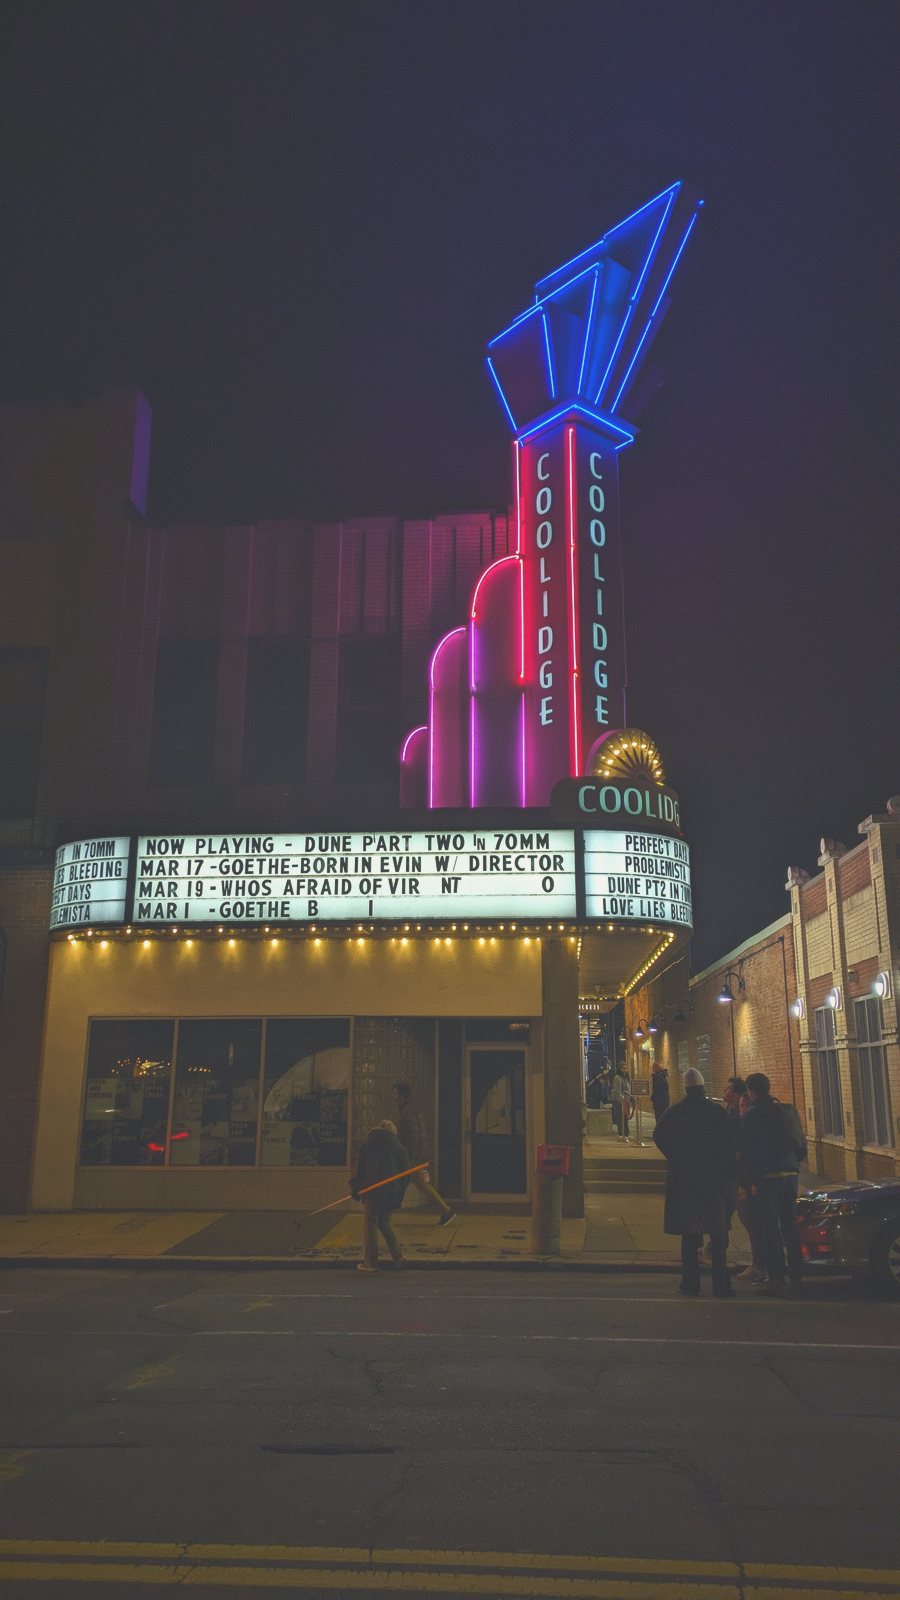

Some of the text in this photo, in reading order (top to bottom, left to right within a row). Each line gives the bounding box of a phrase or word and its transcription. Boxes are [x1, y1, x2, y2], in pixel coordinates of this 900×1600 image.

[536, 452, 554, 726] COOLIDGE
[589, 452, 609, 725] COOLIDGE
[72, 844, 82, 860] IN
[84, 840, 116, 858] 70MM
[146, 839, 185, 856] NOW
[195, 837, 274, 855] PLAYING
[304, 836, 352, 852] DUNE
[425, 834, 465, 851] TWO
[493, 833, 550, 850] 70MM
[625, 834, 671, 856] PERFECT
[69, 860, 123, 882] BLEEDING
[140, 860, 179, 877] MAR
[187, 859, 204, 876] 17
[380, 856, 422, 873] EVIN
[435, 855, 459, 872] W/
[469, 854, 565, 872] DIRECTOR
[625, 856, 687, 881] PROBLEMISTA
[68, 883, 91, 902] DAYS
[138, 881, 178, 898] MAR
[187, 880, 204, 897] 19
[283, 878, 352, 895] AFRAID
[359, 878, 382, 895] OF
[388, 878, 420, 895] VIR
[441, 876, 462, 894] NT
[608, 876, 641, 894] DUNE
[645, 879, 666, 897] PT2
[670, 882, 680, 900] IN
[137, 902, 178, 919] MAR
[307, 899, 319, 916] B
[602, 897, 634, 916] LOVE
[640, 900, 666, 919] LIES
